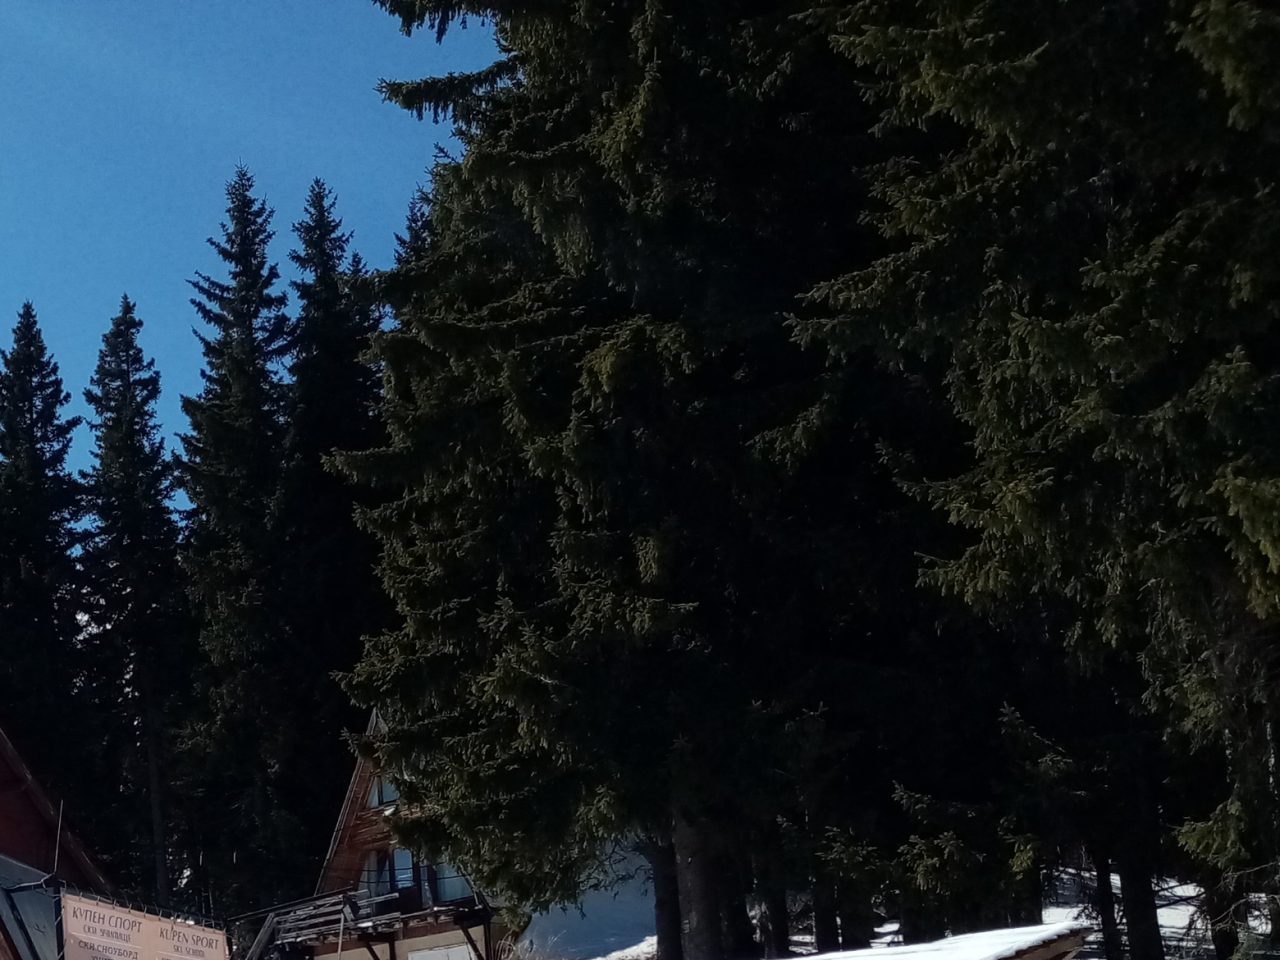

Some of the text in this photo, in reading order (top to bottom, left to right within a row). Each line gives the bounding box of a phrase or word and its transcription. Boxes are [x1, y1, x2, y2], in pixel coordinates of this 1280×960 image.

[72, 906, 143, 933] КУПЕН СПОРТ
[159, 927, 219, 950] KUPEN SPORT
[97, 944, 138, 960] СНОУБОРД
